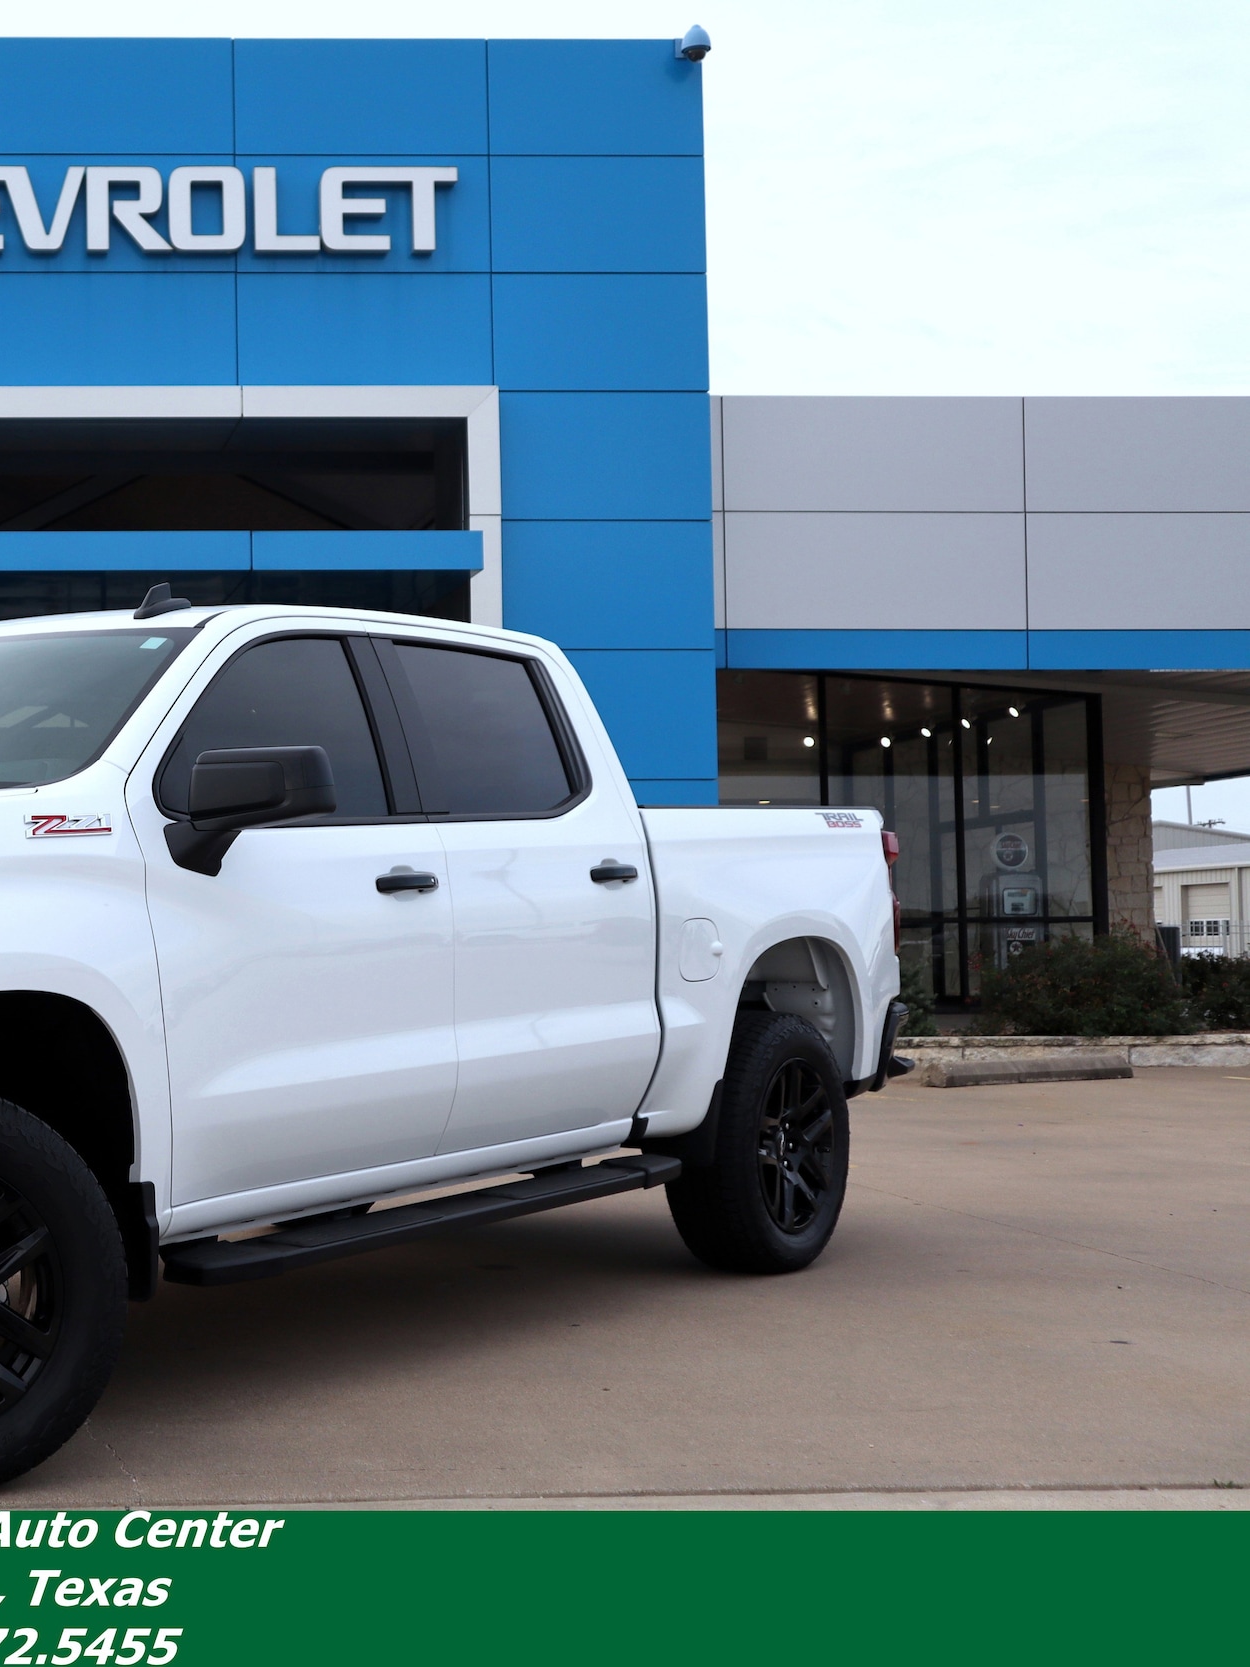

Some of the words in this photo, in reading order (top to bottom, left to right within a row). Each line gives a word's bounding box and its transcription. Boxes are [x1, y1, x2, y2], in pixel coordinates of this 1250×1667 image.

[814, 812, 864, 821] TRAIL
[24, 813, 112, 838] Z71
[826, 820, 862, 828] BOSS
